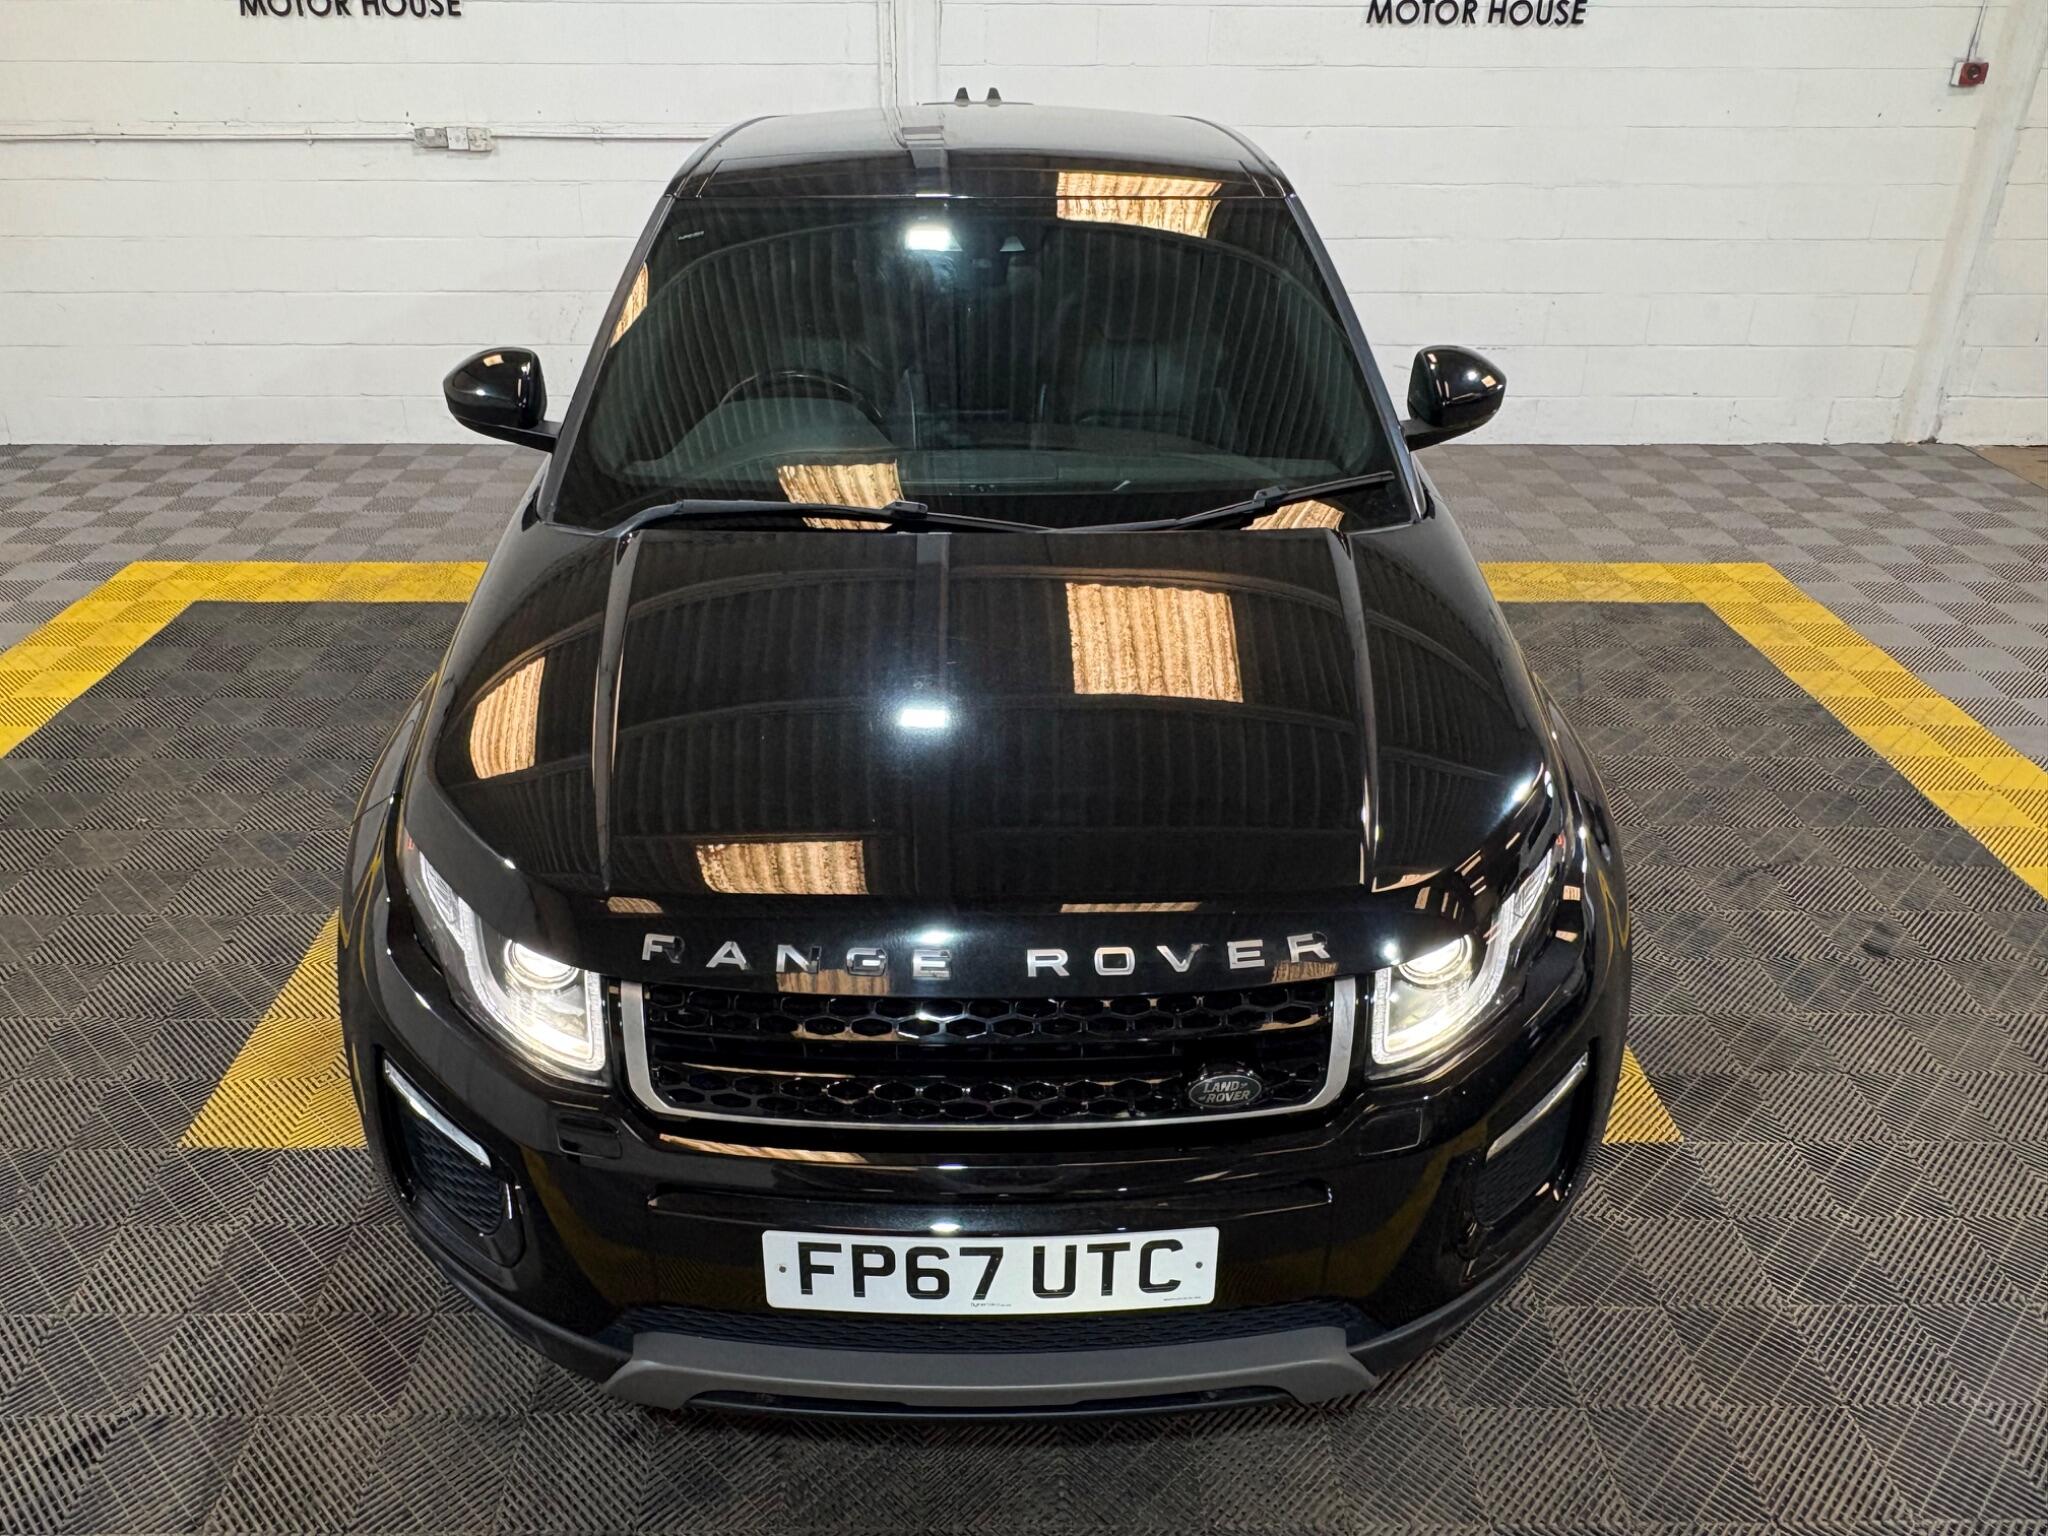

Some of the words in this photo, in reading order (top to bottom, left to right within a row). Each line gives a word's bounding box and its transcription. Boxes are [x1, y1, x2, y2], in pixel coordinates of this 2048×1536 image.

[240, 0, 352, 17] MOTOR
[362, 0, 462, 17] HOUSE
[1366, 0, 1478, 25] MOTOR
[1487, 0, 1588, 26] HOUSE
[641, 933, 951, 980] RANGE
[1026, 930, 1332, 977] ROVER
[1203, 1081, 1240, 1094] LAND
[1204, 1090, 1251, 1103] ROVER
[797, 1241, 1004, 1300] FP67
[1032, 1238, 1184, 1298] UTC
